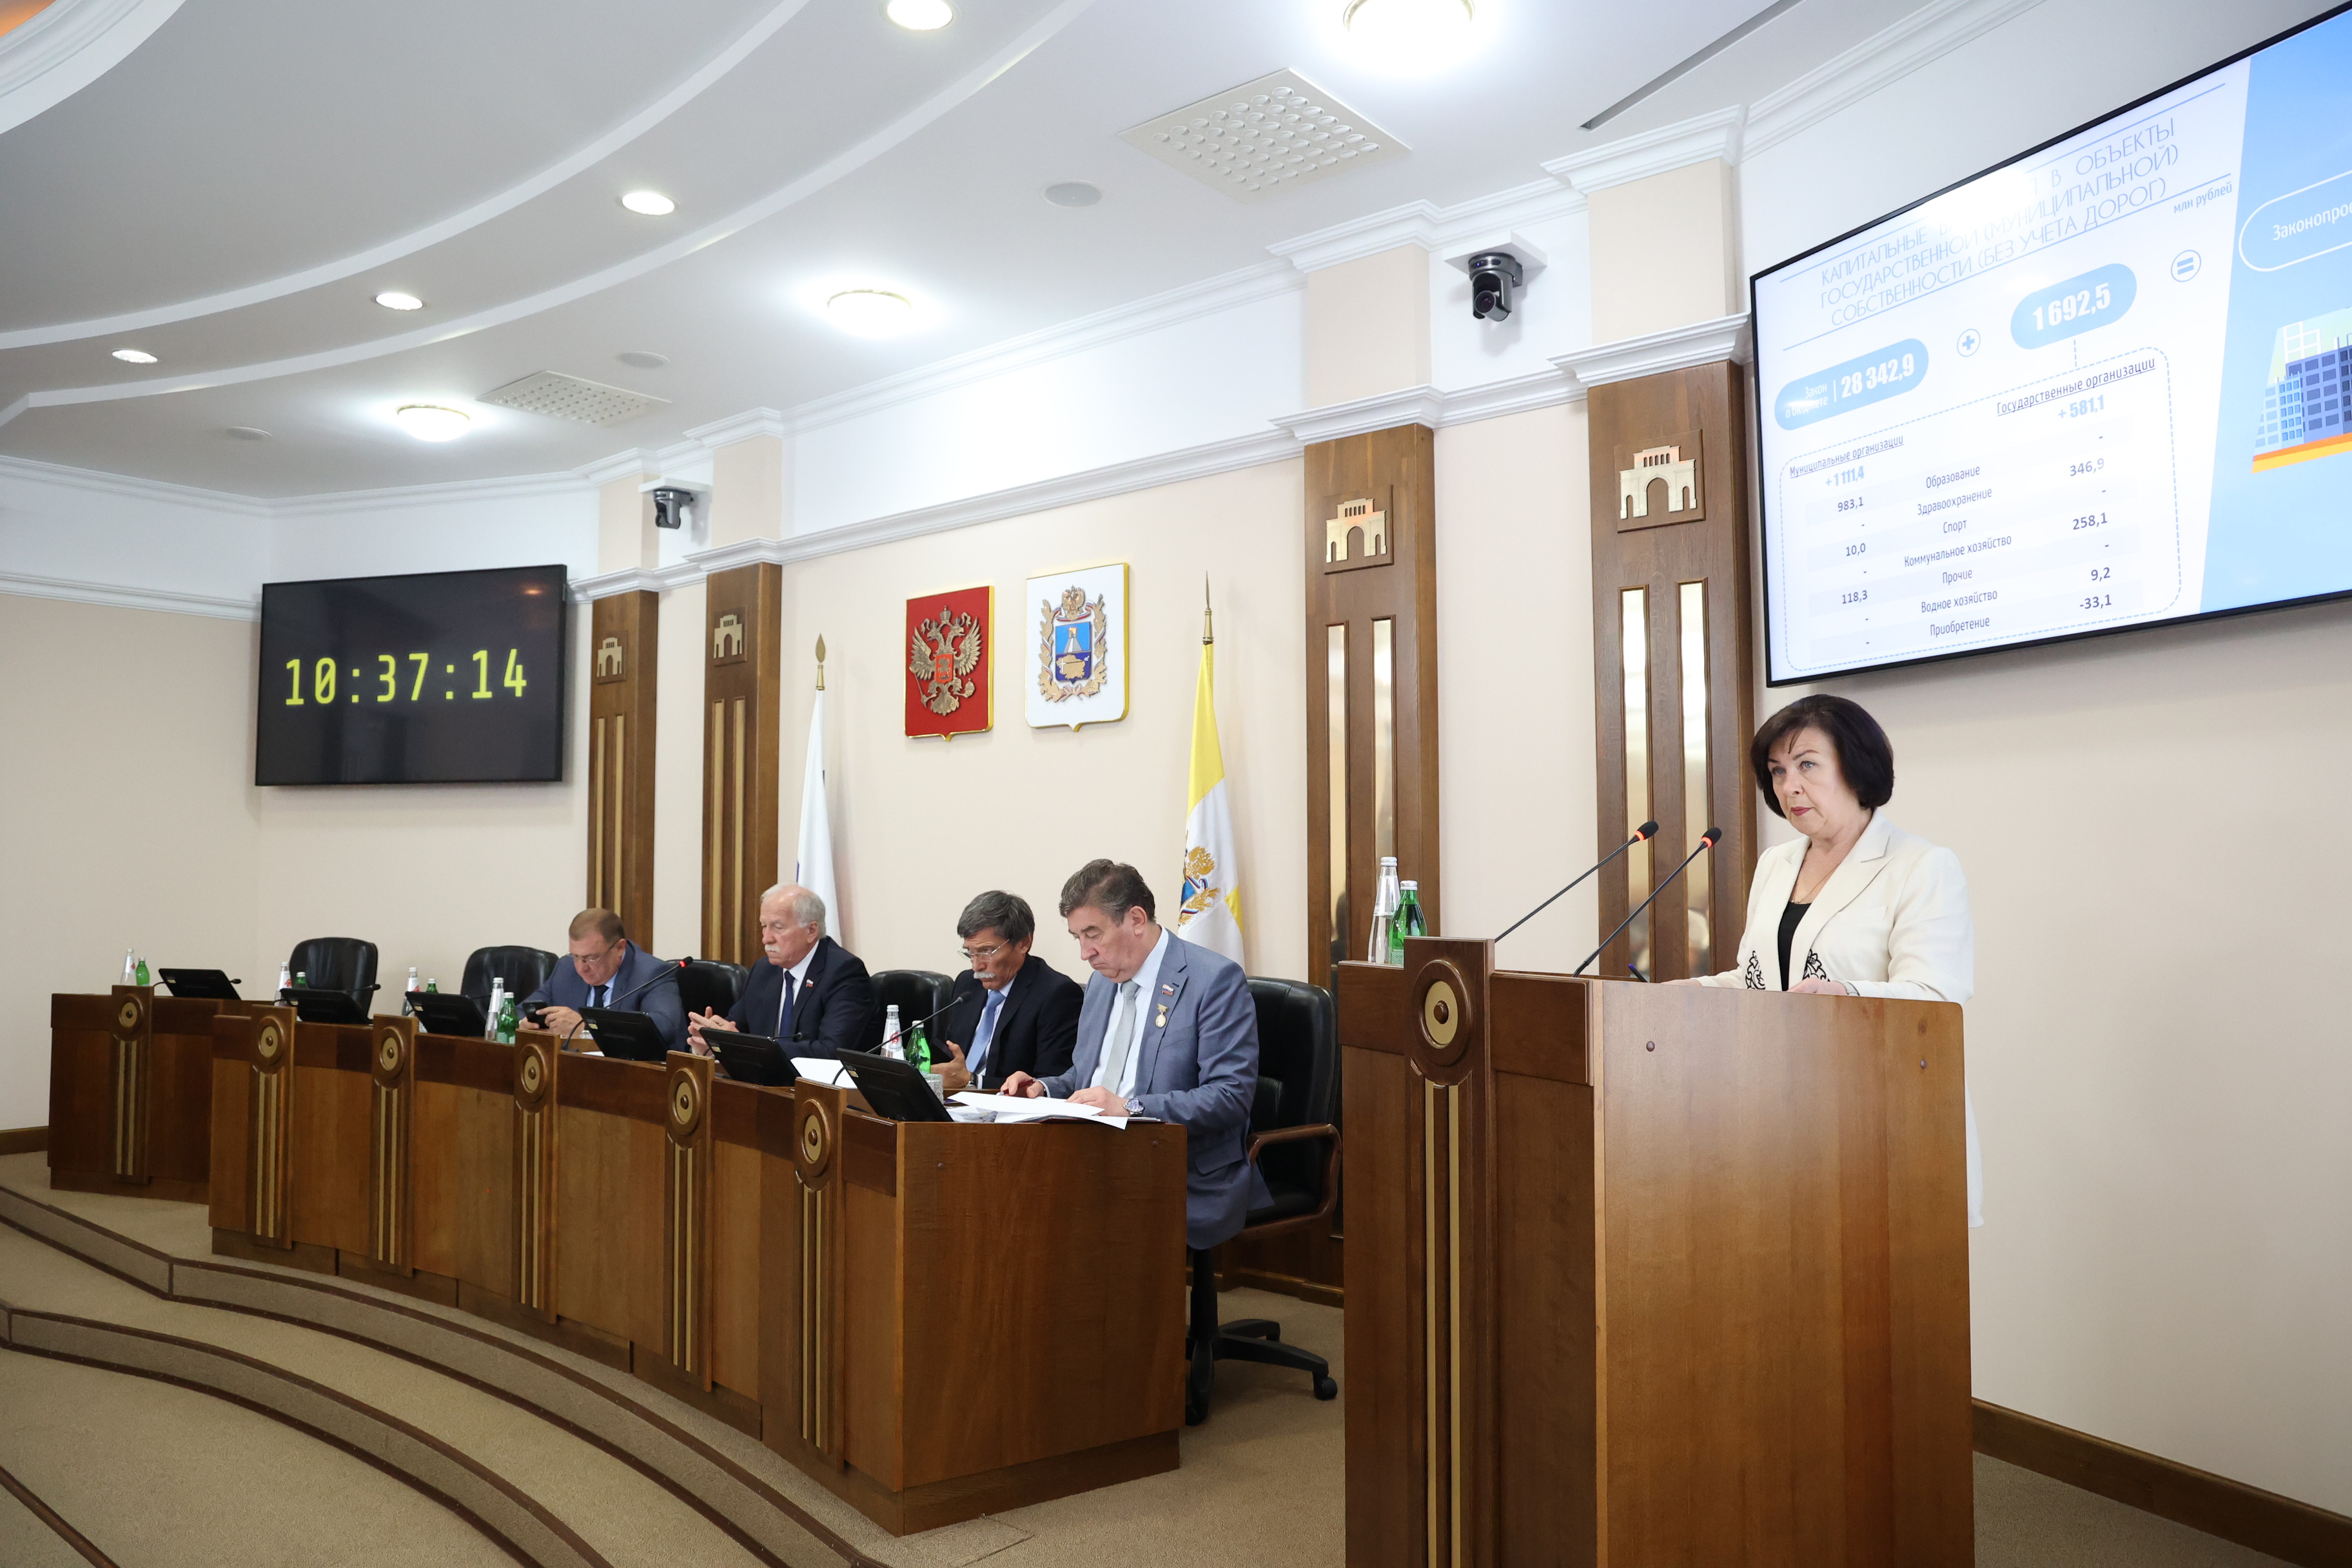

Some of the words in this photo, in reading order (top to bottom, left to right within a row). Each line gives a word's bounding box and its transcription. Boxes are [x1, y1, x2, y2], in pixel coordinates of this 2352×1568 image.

[2076, 118, 2174, 175] ОБЪЕКТЫ
[1984, 144, 2178, 241] (МУНИЦИПАЛЬНОЙ)
[2174, 197, 2193, 214] млн
[2196, 181, 2233, 208] рублей
[1822, 226, 1928, 286] КАПИТАЛЬНЫЕ
[1832, 257, 1972, 326] СОБСТВЕННОСТИ
[1978, 239, 2014, 269] (БЕЗ
[2019, 215, 2077, 252] УЧЕТА
[2084, 177, 2166, 231] ДОРОГ)
[2047, 282, 2110, 326] 692,5
[1841, 371, 1863, 398] 28
[1866, 353, 1915, 389] 342,9
[1997, 380, 2082, 414] Государственные
[2086, 358, 2155, 388] организации
[1804, 382, 1828, 399] Закон
[2070, 394, 2104, 418] 581,1
[1790, 452, 1850, 476] Муниципальные
[1852, 435, 1904, 460] организации
[2070, 457, 2104, 476] 346,9
[1926, 465, 1981, 489] Образование
[1838, 496, 1864, 512] 983,1
[1917, 488, 1992, 516] Здравоохранение
[1943, 520, 1967, 534] Спорт
[2073, 513, 2108, 530] 258,1
[1845, 543, 1866, 557] 10,0
[1904, 545, 1965, 567] Коммунальное
[1967, 535, 2012, 554] хозяйство
[1942, 569, 1973, 585] Прочие
[2091, 567, 2111, 582] 9,2
[1841, 590, 1868, 605] 118,3
[1921, 597, 1952, 613] Водное
[1954, 590, 1997, 608] хозяйство
[2079, 594, 2112, 609] -33,1
[1930, 617, 1990, 638] Приобретение
[285, 648, 527, 706] 10:37:14
